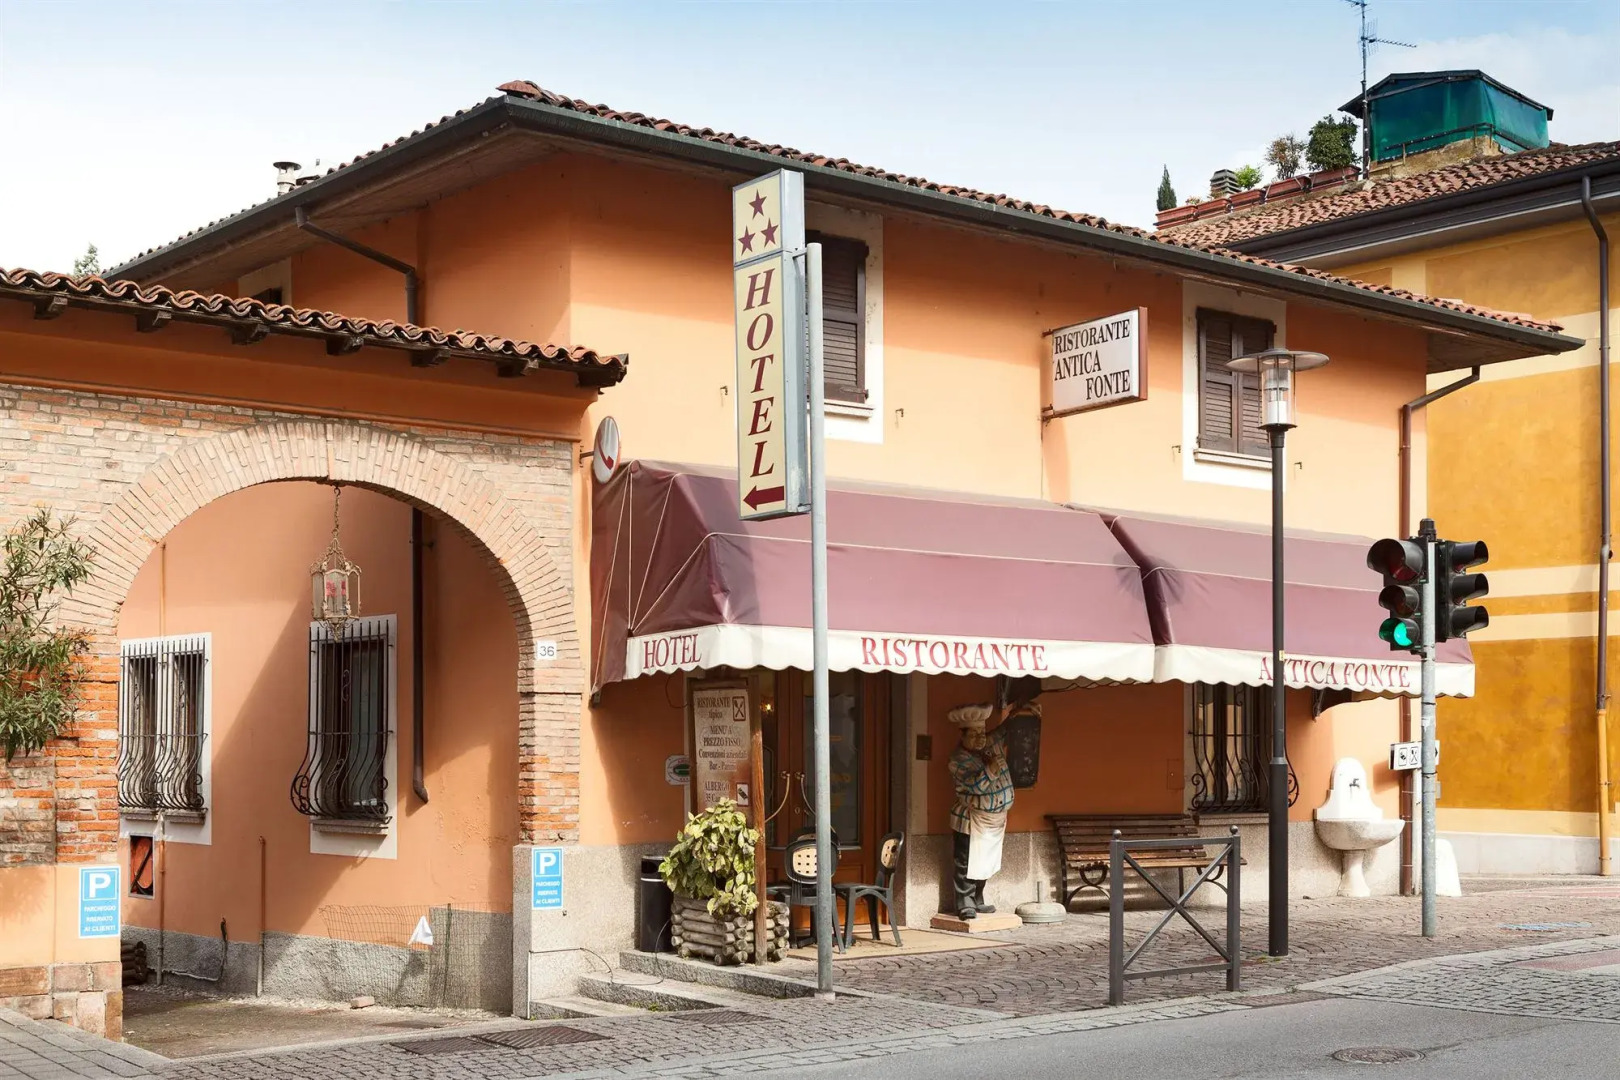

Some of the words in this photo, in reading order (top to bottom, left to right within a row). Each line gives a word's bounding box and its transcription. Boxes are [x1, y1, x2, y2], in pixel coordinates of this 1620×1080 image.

[1054, 319, 1131, 354] RISTORANTE
[743, 267, 775, 478] HOTEL
[1054, 350, 1102, 381] ANTICA
[1086, 369, 1131, 400] FONTE
[539, 645, 555, 657] 36
[643, 634, 702, 669] HOTEL
[861, 636, 1048, 671] RISTORANTE
[1258, 656, 1338, 685] ATICA
[1344, 662, 1411, 688] FONTE
[697, 697, 731, 708] RISTORANTE
[703, 737, 725, 747] PREZZO
[709, 762, 718, 771] Bar
[539, 852, 557, 874] P
[89, 872, 111, 898] P
